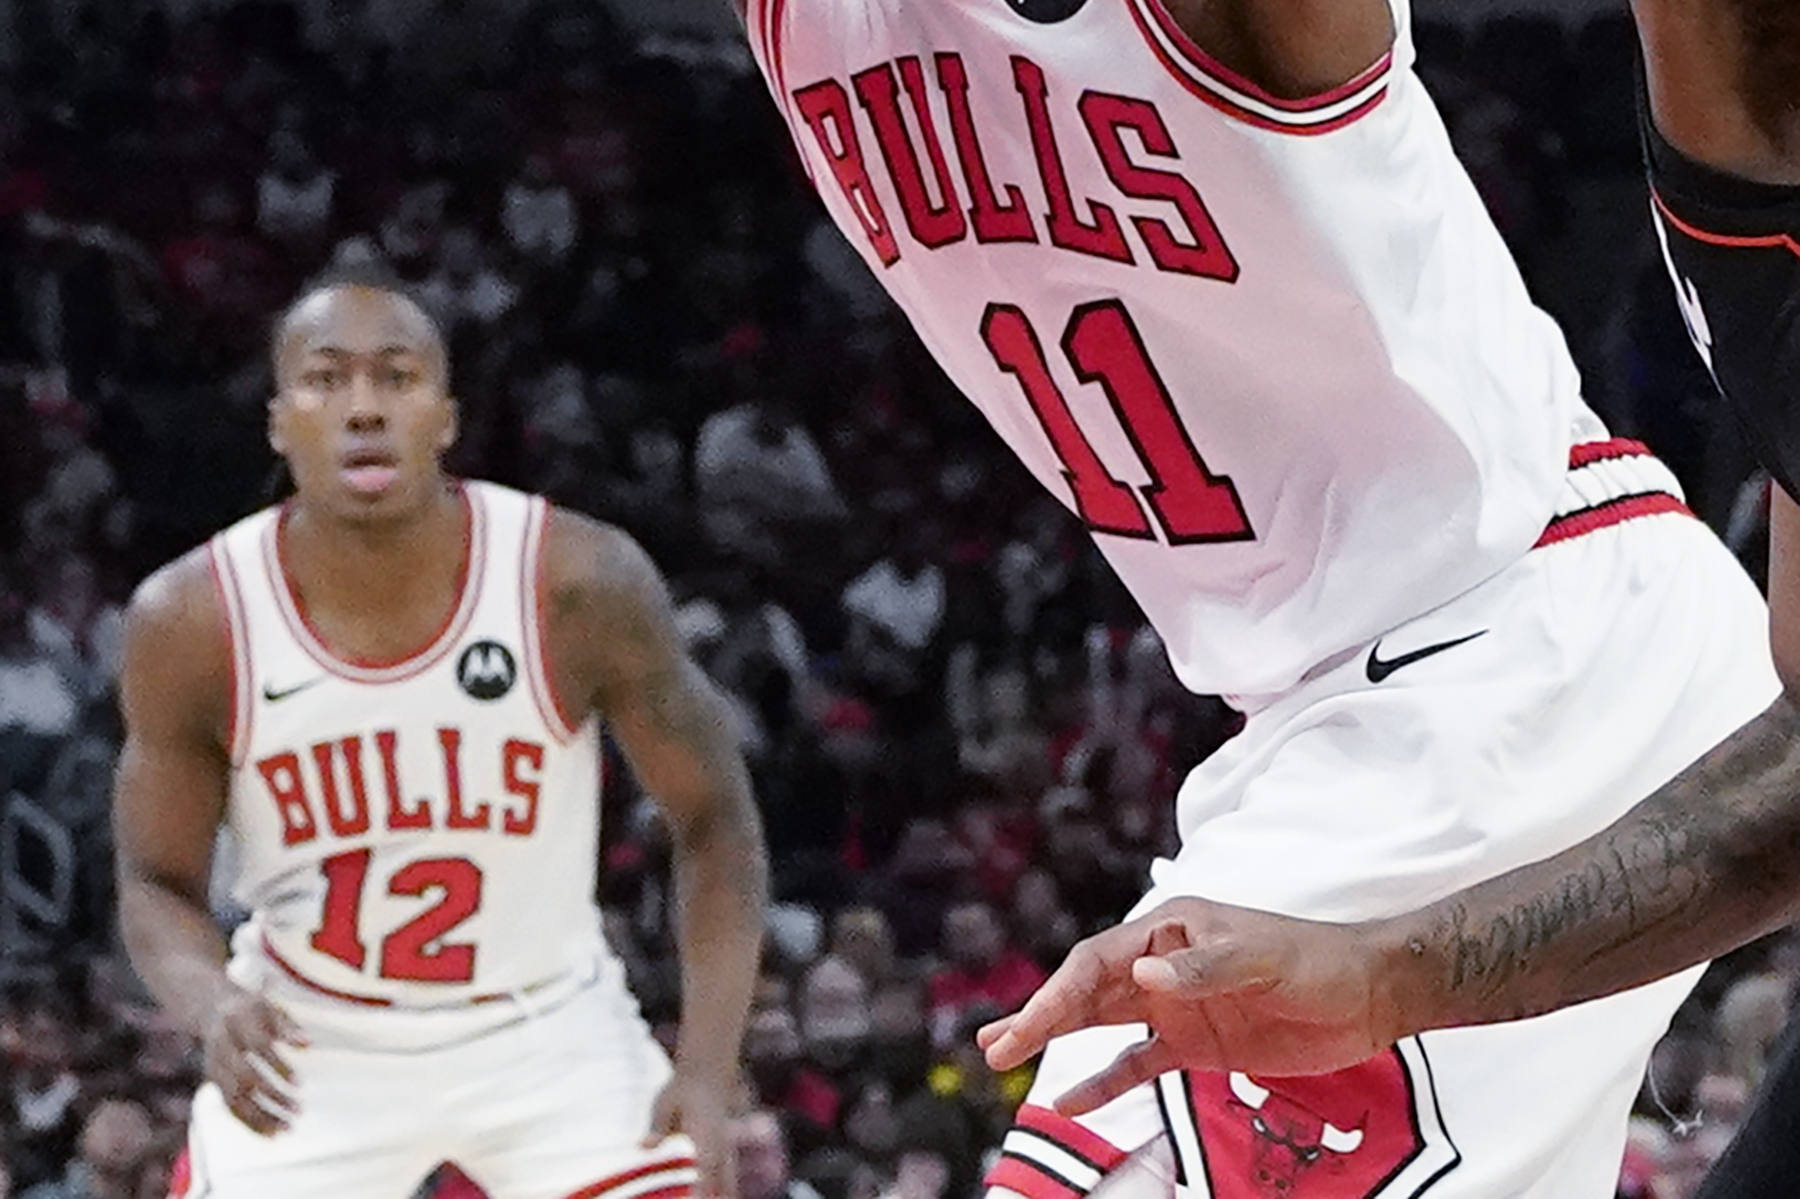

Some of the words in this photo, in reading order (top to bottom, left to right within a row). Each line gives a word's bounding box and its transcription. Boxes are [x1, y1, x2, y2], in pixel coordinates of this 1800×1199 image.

[792, 51, 1240, 285] BULLS
[979, 297, 1257, 547] 11
[256, 726, 545, 847] BULLS
[310, 846, 484, 984] 12
